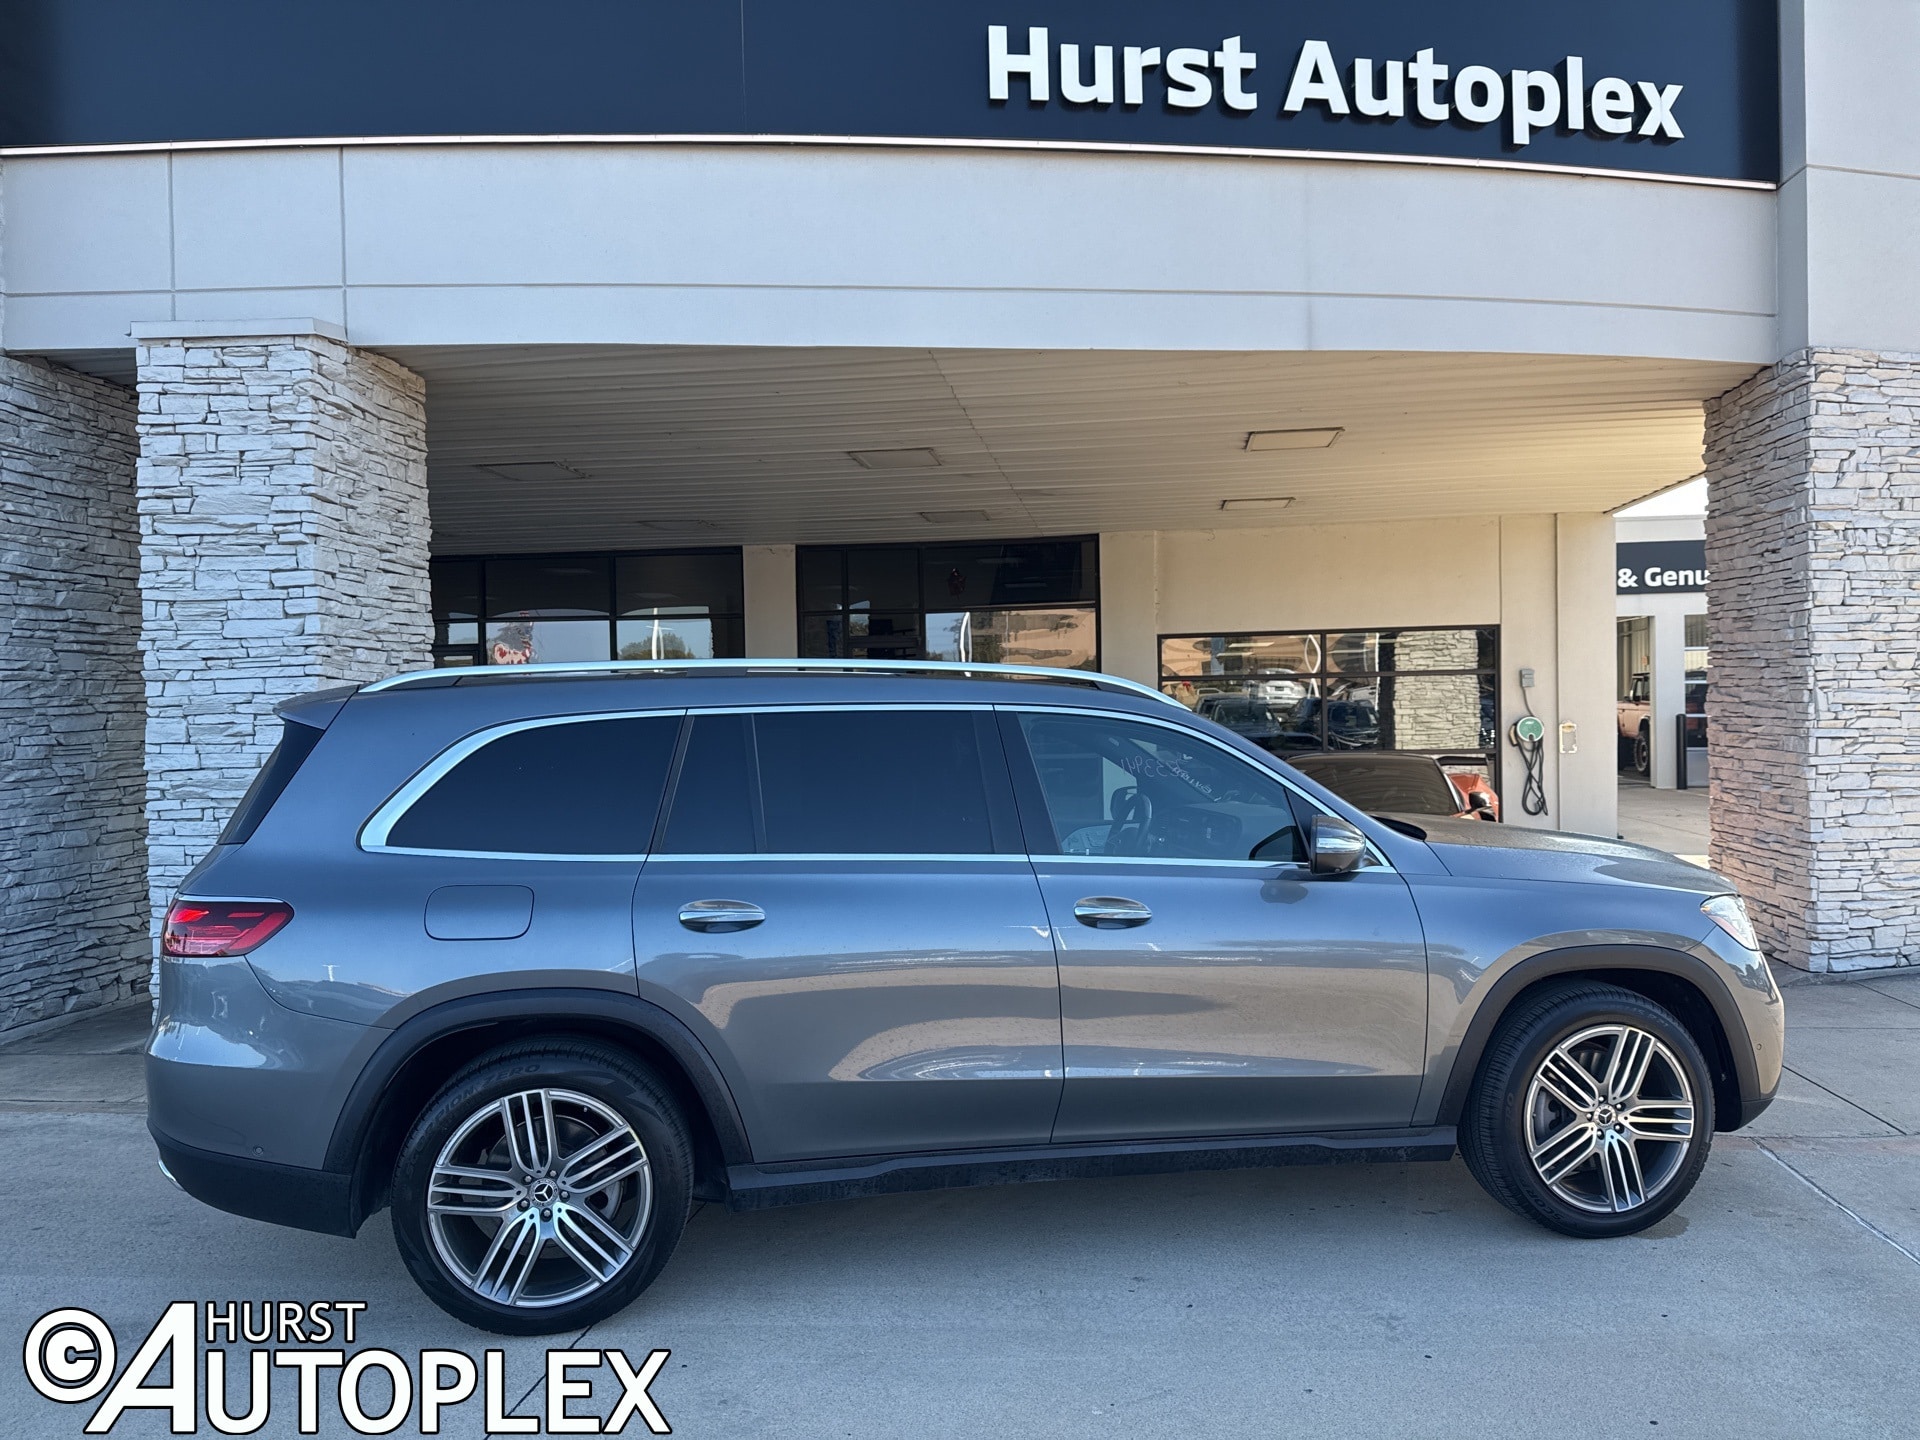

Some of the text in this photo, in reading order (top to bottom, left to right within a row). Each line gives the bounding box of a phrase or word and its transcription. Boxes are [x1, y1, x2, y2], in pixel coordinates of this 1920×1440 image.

[987, 25, 1684, 144] Hurst Autoplex
[1617, 567, 1711, 588] & Genu
